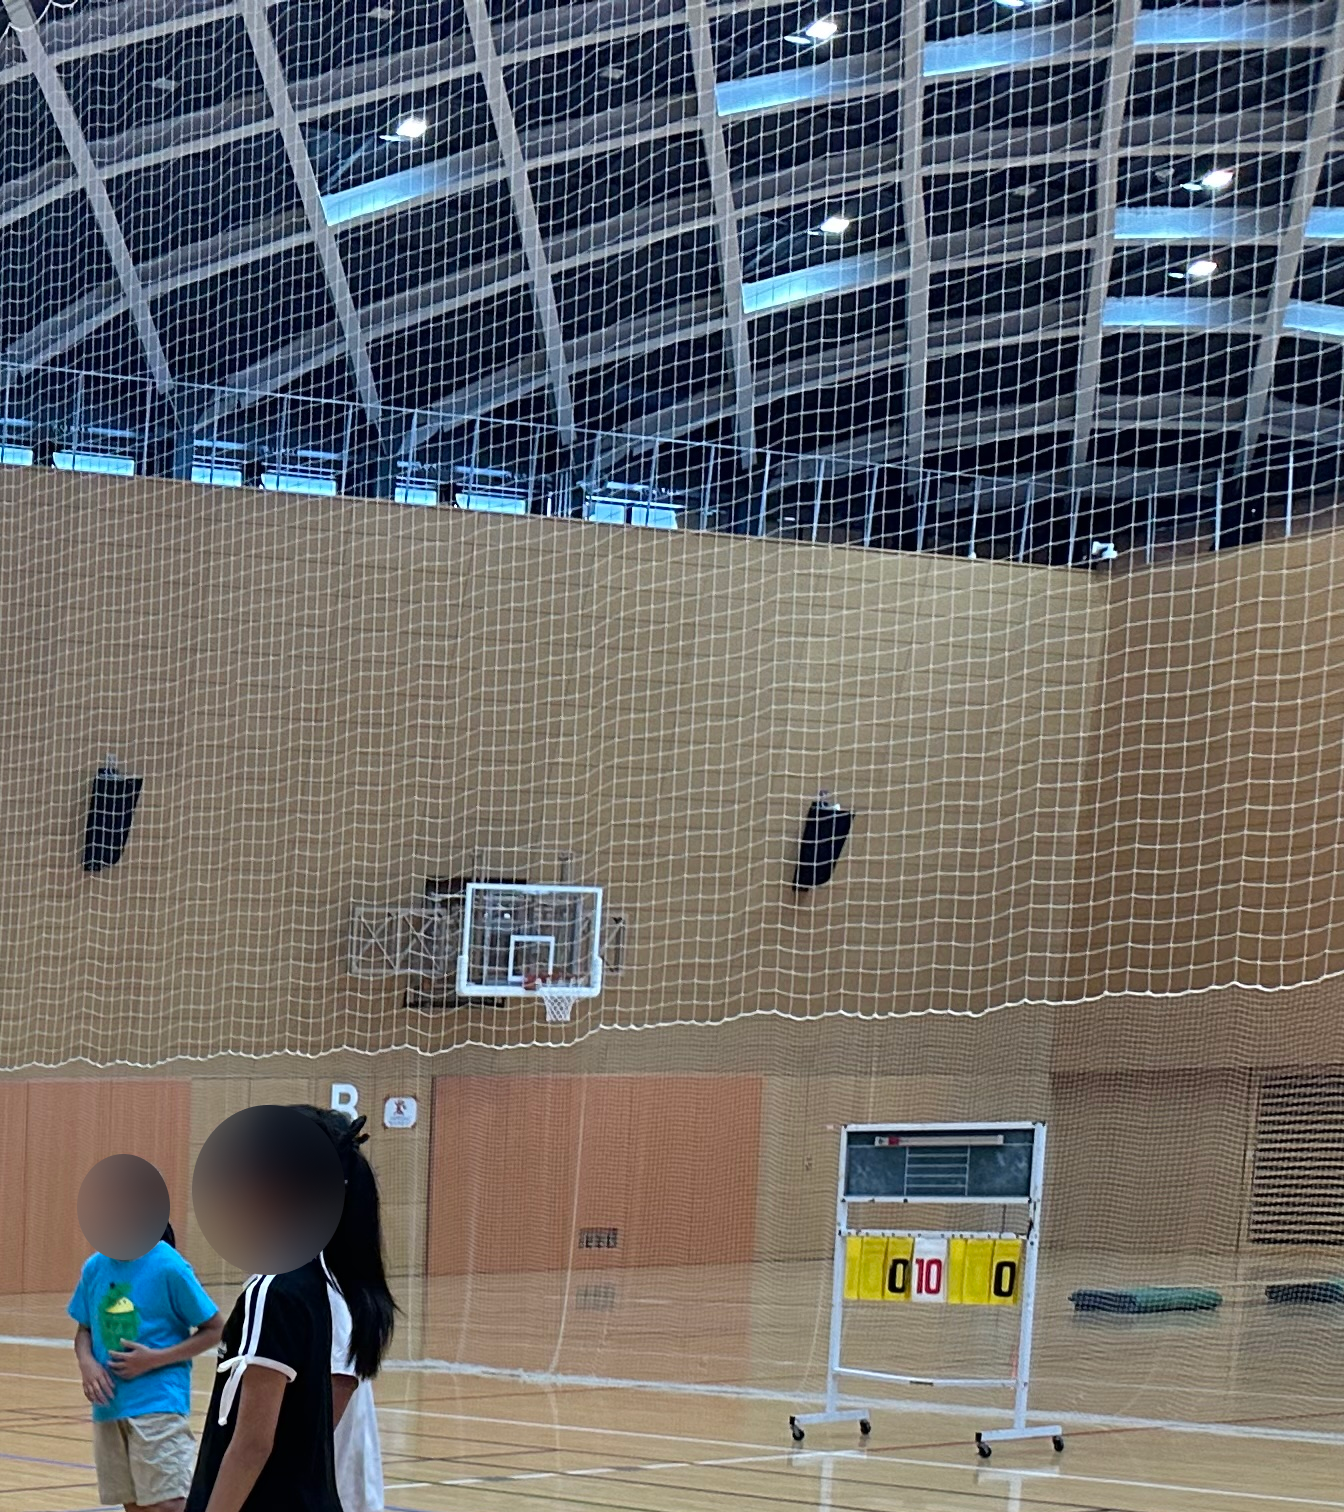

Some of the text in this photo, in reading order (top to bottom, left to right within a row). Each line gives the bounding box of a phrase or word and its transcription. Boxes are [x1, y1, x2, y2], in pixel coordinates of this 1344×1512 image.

[887, 1258, 1017, 1298] 0 10 0
